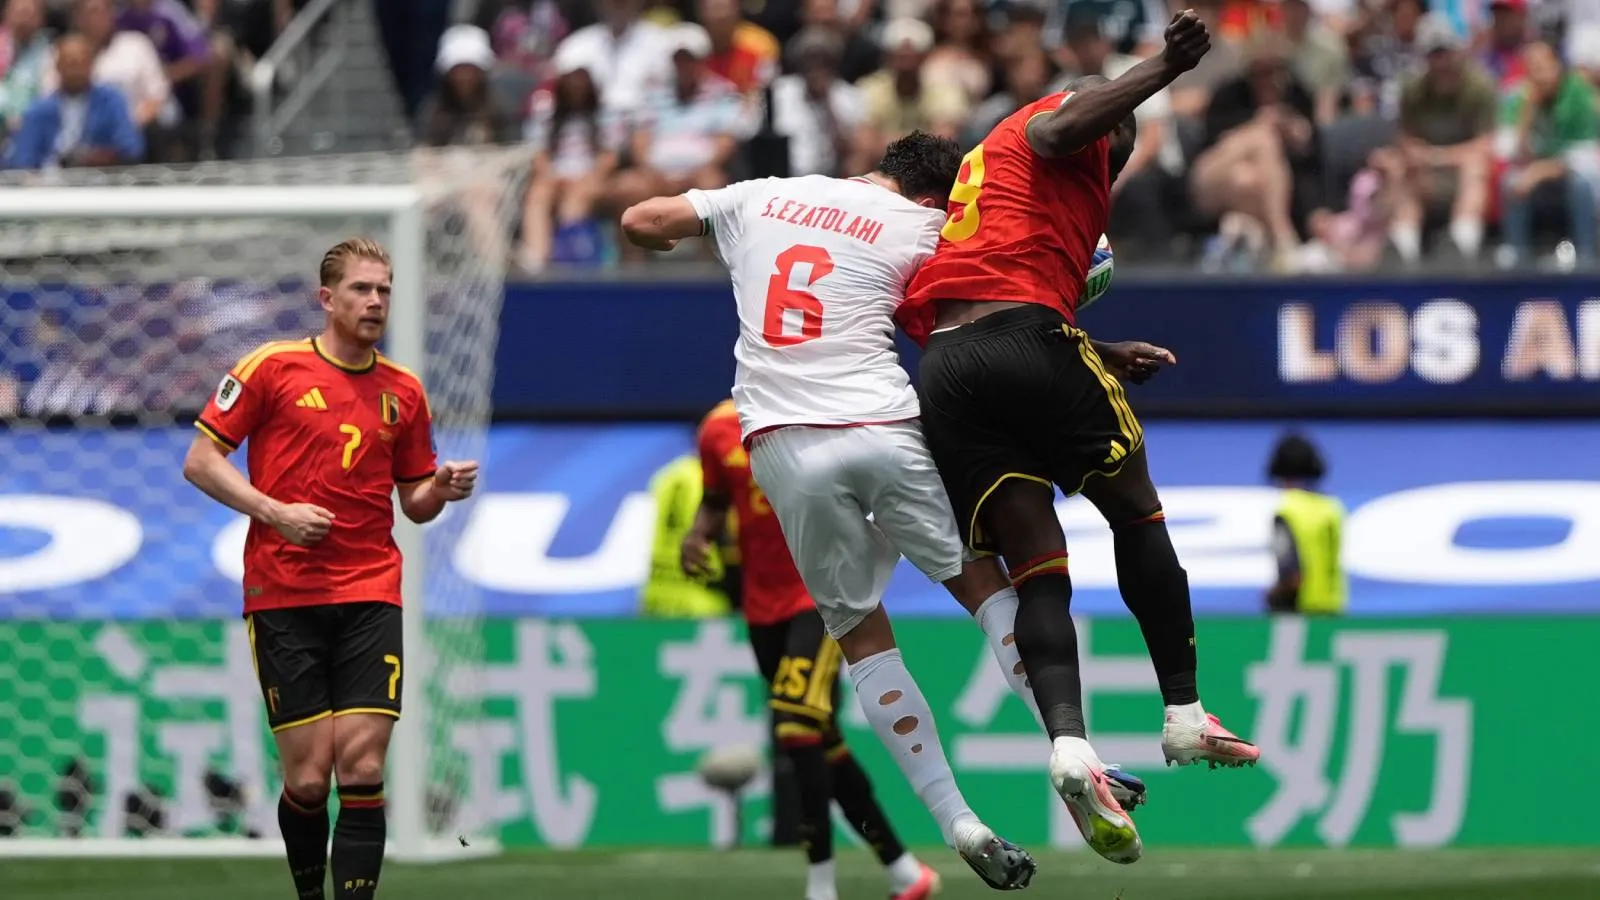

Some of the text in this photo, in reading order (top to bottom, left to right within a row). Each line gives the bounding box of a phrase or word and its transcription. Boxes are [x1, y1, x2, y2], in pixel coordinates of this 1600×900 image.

[761, 196, 884, 245] S.EZATOLAHI
[940, 143, 986, 242] 9
[762, 243, 835, 348] 6
[1278, 298, 1481, 384] LOS
[339, 423, 362, 470] 7
[384, 654, 401, 700] 7
